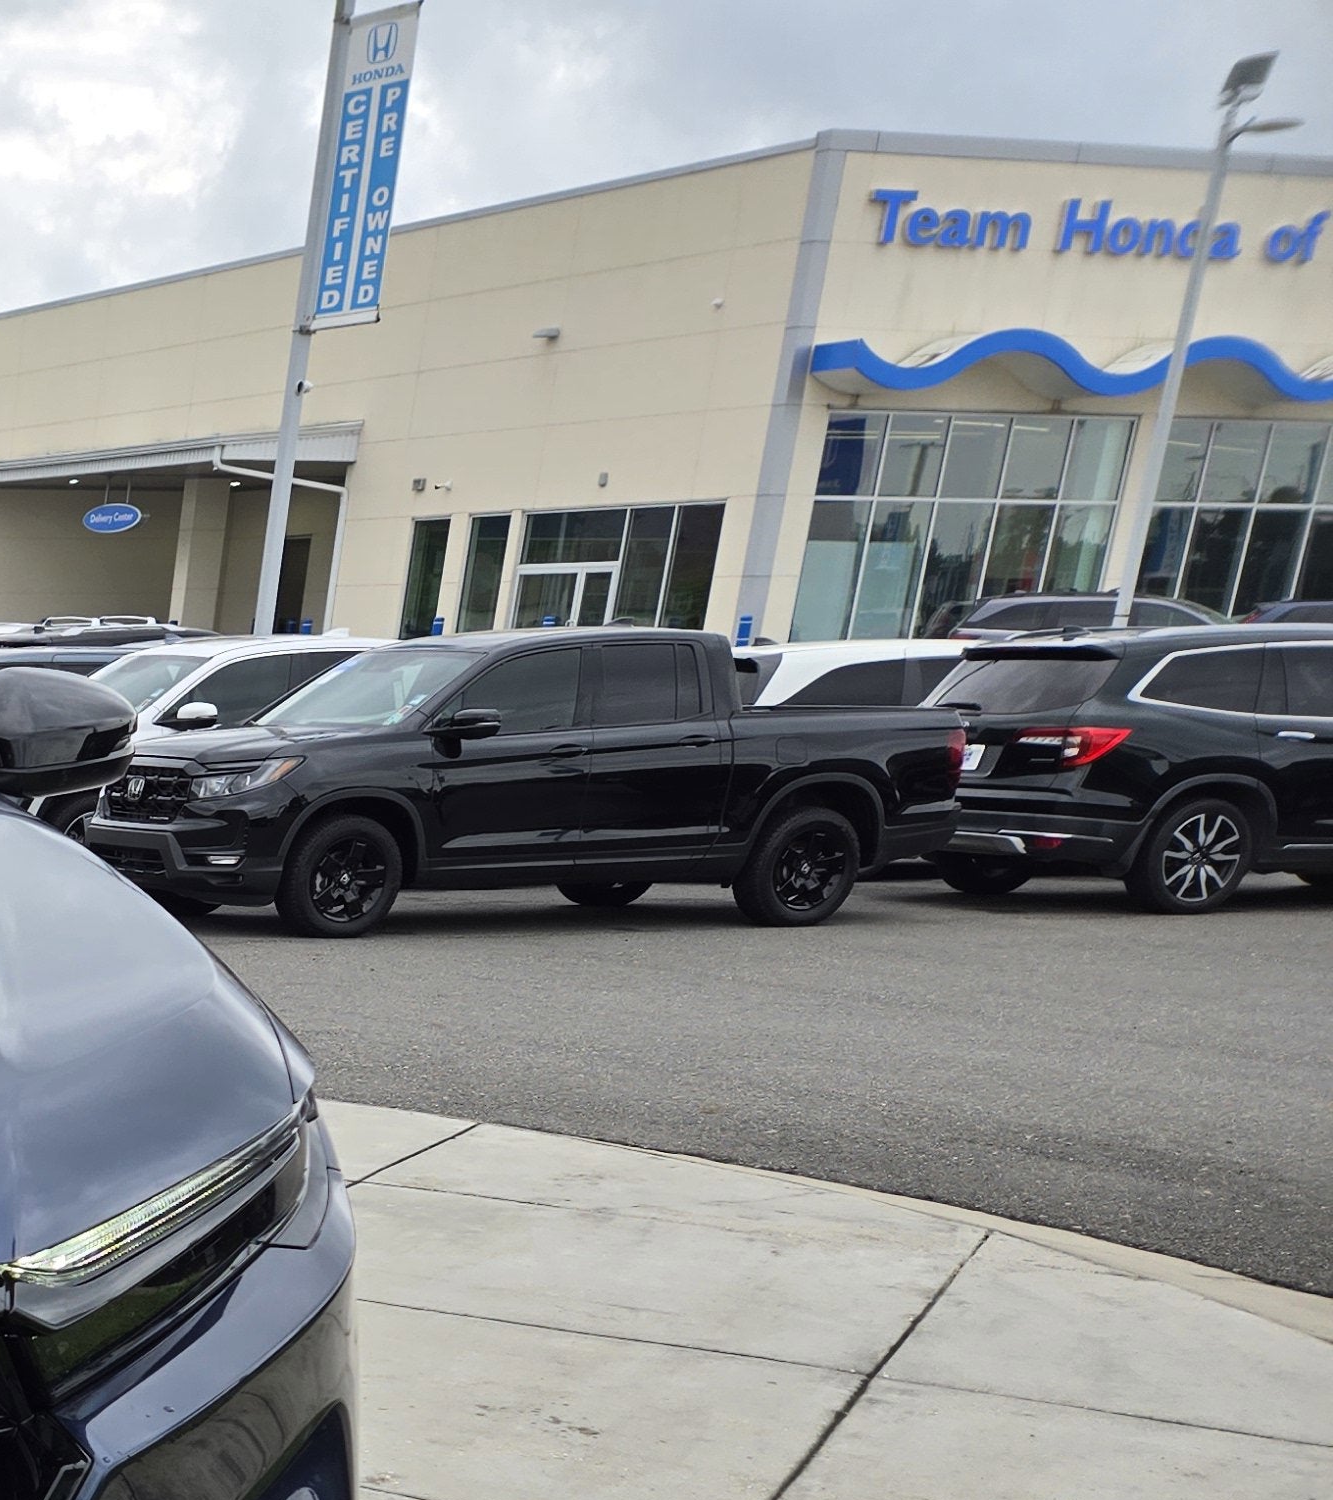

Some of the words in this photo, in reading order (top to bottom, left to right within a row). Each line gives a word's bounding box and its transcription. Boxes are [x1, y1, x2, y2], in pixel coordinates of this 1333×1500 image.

[352, 63, 405, 86] HONDA
[379, 87, 402, 158] PRE
[320, 94, 367, 310] CERTIFIED
[871, 188, 1032, 250] Team
[1267, 209, 1332, 263] of
[357, 186, 390, 305] OWNED
[90, 513, 113, 525] Delivery
[114, 512, 134, 522] Center
